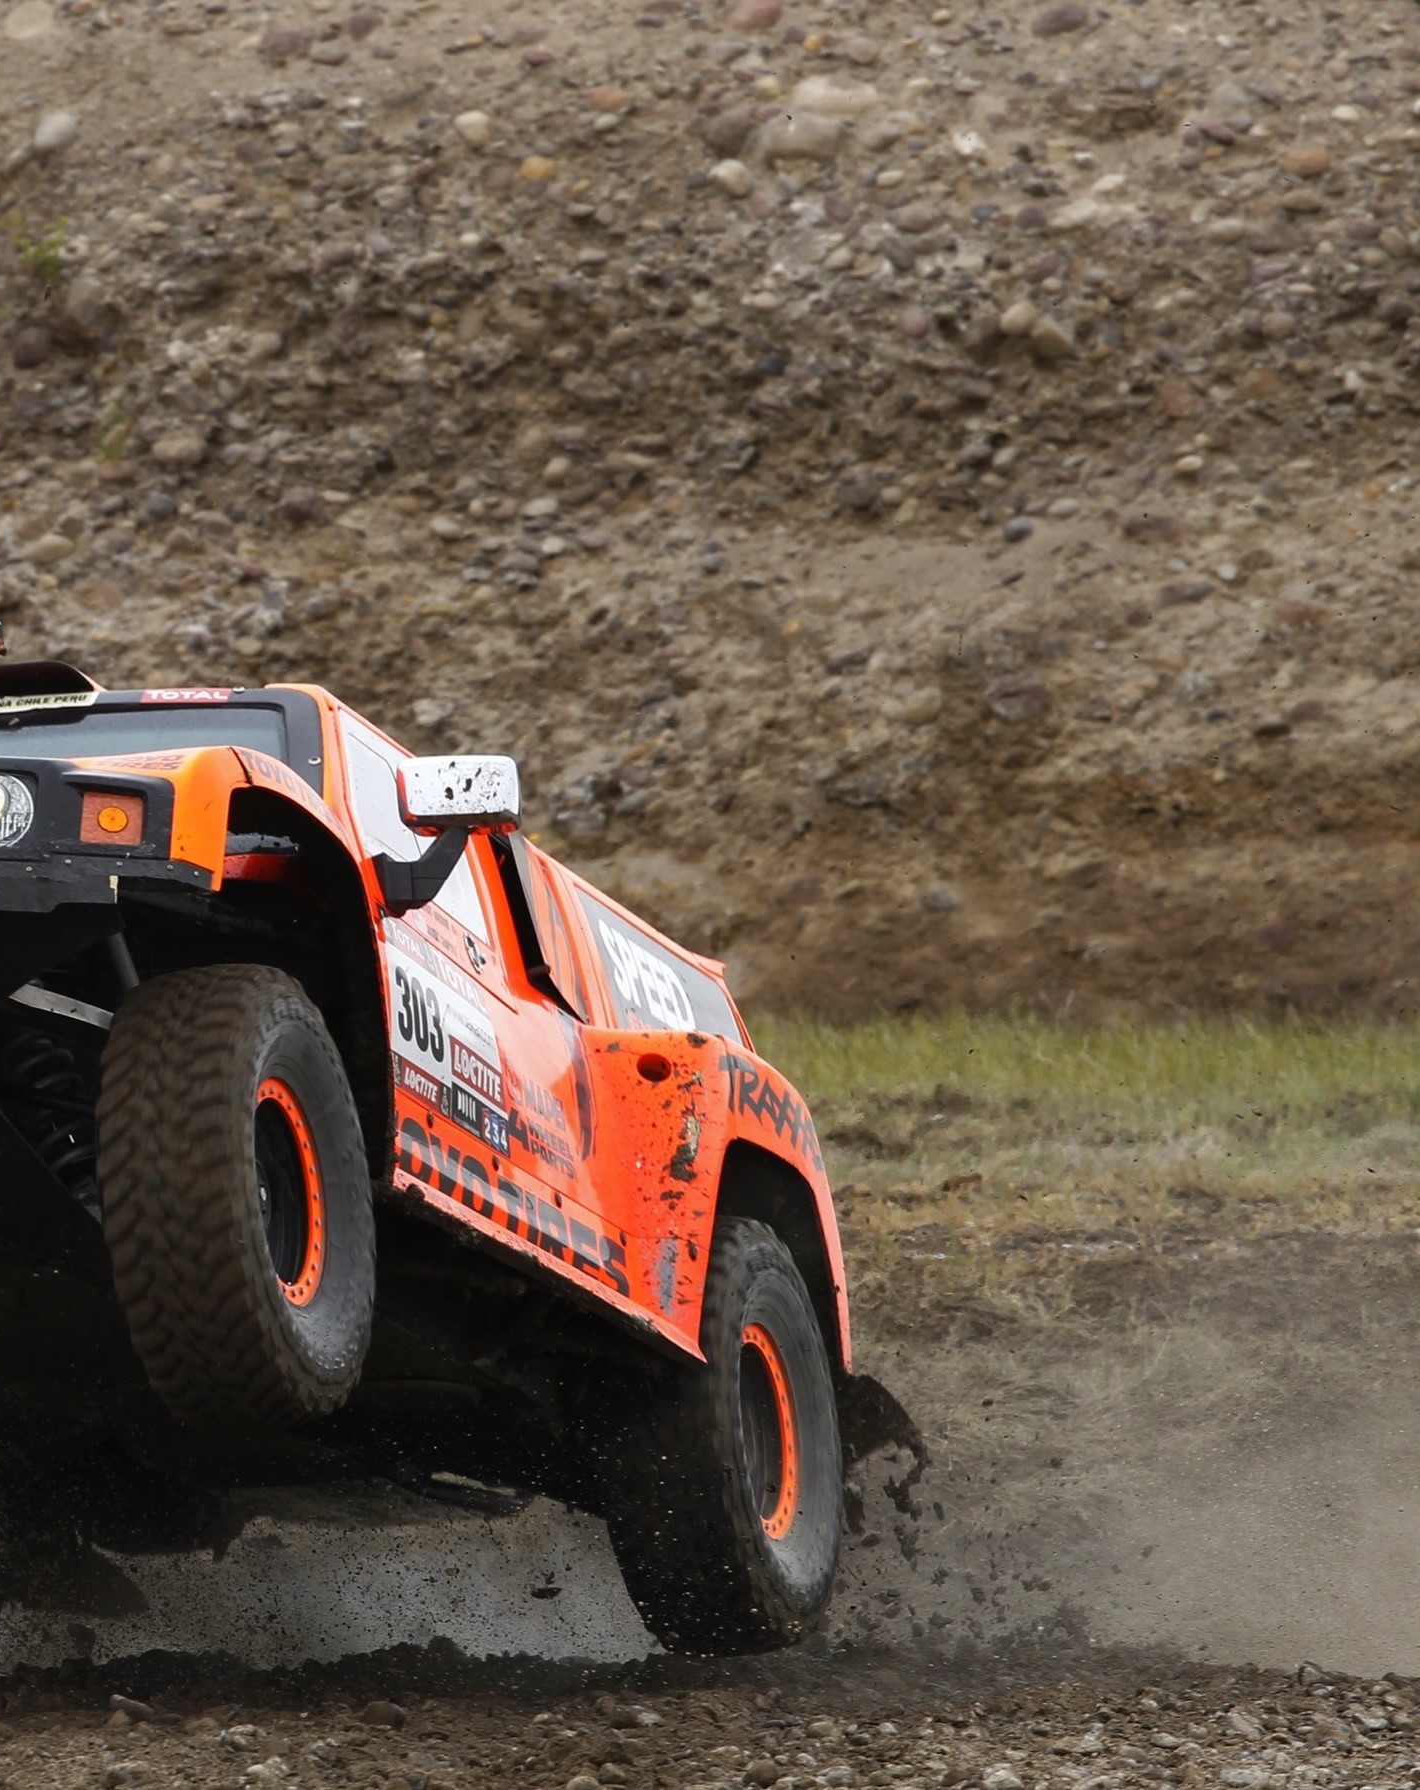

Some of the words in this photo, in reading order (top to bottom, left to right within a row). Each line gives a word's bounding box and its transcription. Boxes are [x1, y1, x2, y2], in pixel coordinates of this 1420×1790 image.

[16, 696, 50, 707] CHILE
[53, 694, 88, 704] PERU
[145, 689, 230, 701] TOTAL
[392, 921, 425, 960] TOTAL
[434, 956, 488, 1015] TOTAL
[598, 919, 696, 1030] SPEED
[395, 965, 444, 1064] 303
[404, 1066, 438, 1103] LOCTITE
[454, 1043, 501, 1103] LOCTITE
[507, 1107, 530, 1153] 4
[529, 1138, 576, 1180] PARTS
[394, 1112, 494, 1219] OYO
[498, 1175, 630, 1298] TIRES
